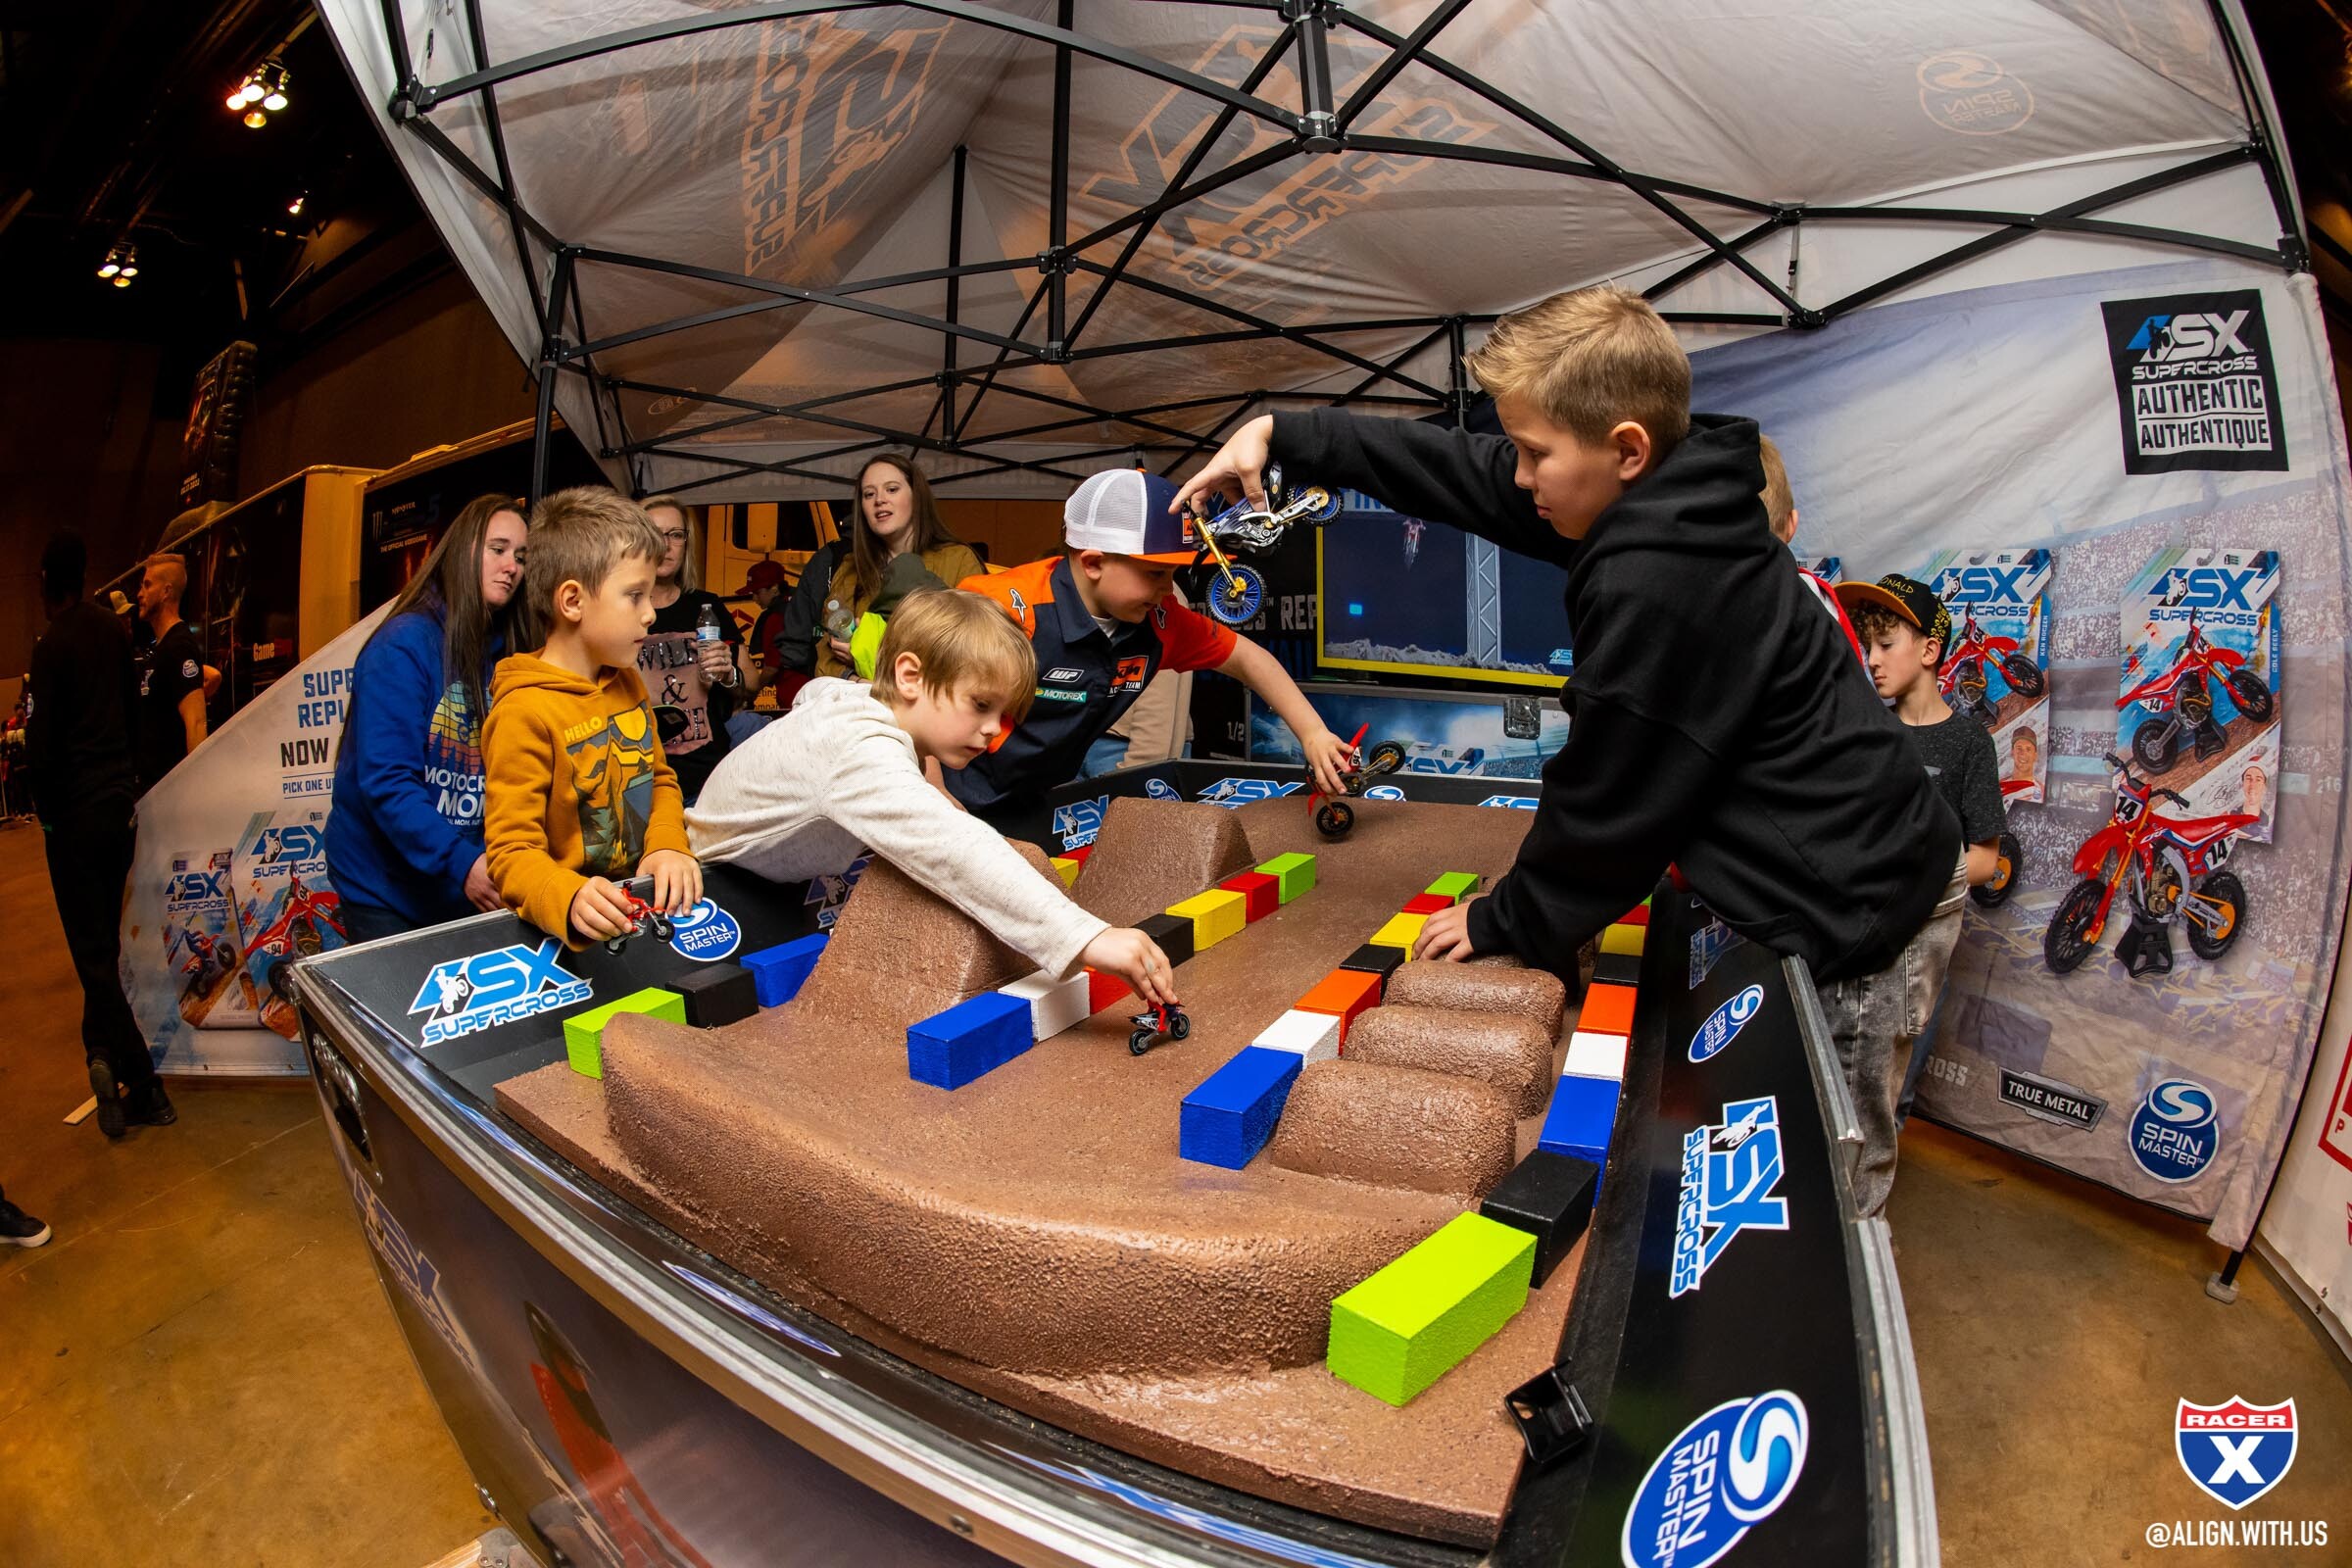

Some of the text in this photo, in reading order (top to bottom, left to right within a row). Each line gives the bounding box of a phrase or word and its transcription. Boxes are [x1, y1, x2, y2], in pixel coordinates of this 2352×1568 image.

[2132, 356, 2258, 380] SUPERCROSS
[2137, 378, 2265, 416] AUTHENTIC
[2141, 418, 2270, 449] AUTHENTIQUE
[253, 642, 275, 662] Game
[662, 674, 688, 705] &
[1043, 689, 1084, 702] MOTOREX
[2148, 698, 2161, 711] 14
[564, 715, 603, 744] HELLO
[280, 737, 329, 768] NOW
[282, 780, 303, 795] PICK
[305, 778, 323, 792] ONE
[2115, 796, 2139, 822] 14
[2208, 838, 2229, 866] 14
[167, 900, 229, 912] SUPERCROSS
[679, 922, 727, 944] SPIN
[423, 981, 591, 1046] SUPERCROSS
[1714, 1009, 1727, 1046] SPIN
[2008, 1079, 2089, 1121] TRUE METAL
[2141, 1121, 2204, 1155] SPIN
[1673, 1128, 1705, 1295] SUPERCROSS
[1677, 1429, 1721, 1550] SPIN
